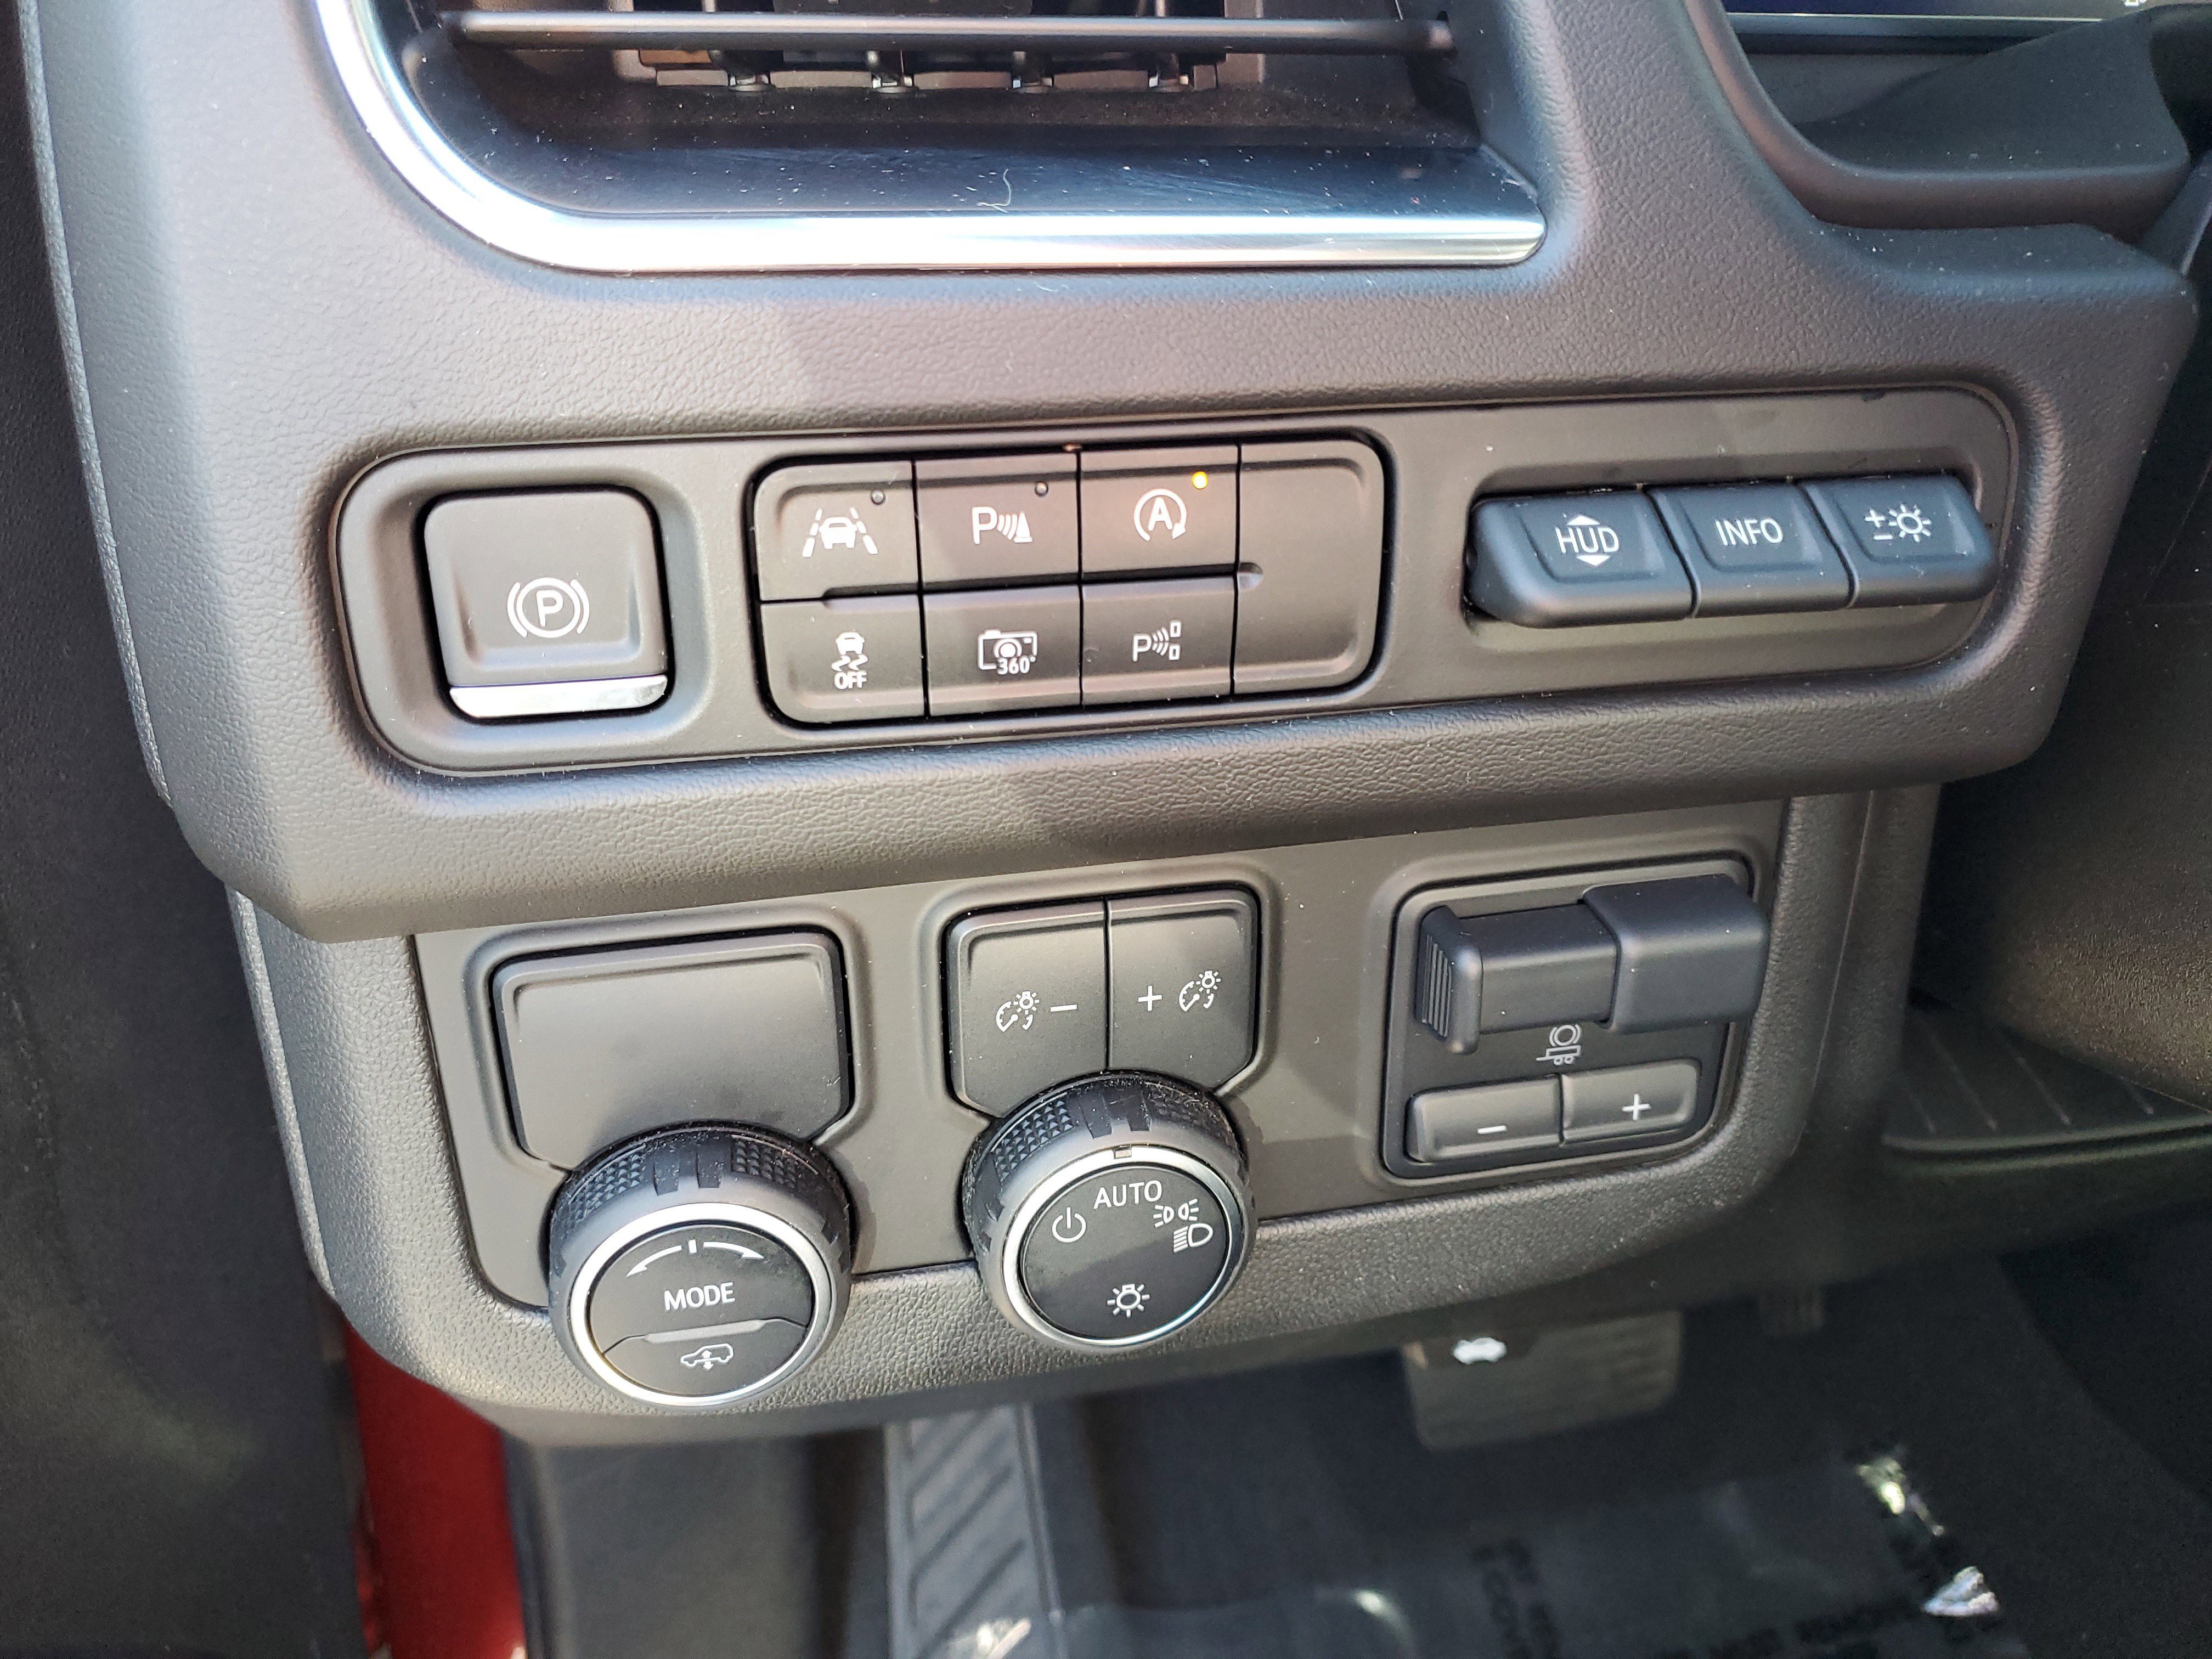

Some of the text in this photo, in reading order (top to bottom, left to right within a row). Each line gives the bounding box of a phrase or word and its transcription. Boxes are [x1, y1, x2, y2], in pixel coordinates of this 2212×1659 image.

[972, 507, 997, 544] P
[1148, 498, 1172, 531] A
[1556, 527, 1619, 554] HUD
[1715, 518, 1783, 546] INFO
[536, 590, 563, 627] P
[1132, 633, 1152, 662] P
[834, 670, 867, 690] OFF
[1093, 1180, 1163, 1209] AUTO
[664, 1282, 736, 1311] MODE
